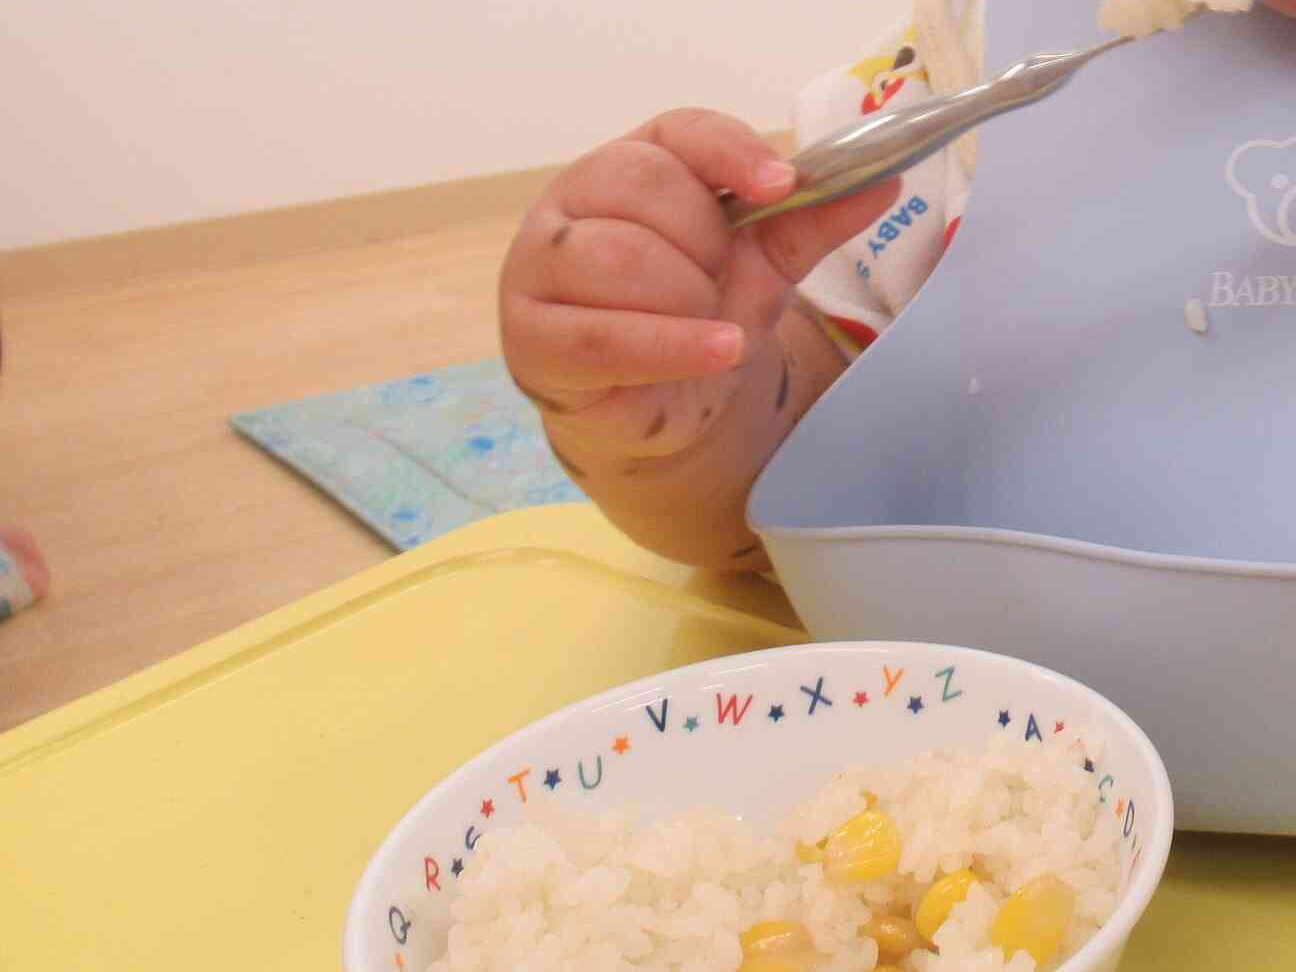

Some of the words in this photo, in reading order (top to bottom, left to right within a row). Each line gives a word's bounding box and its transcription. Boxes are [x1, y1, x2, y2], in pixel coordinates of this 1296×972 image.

[870, 195, 929, 259] BABY
[389, 906, 411, 945] Q
[424, 856, 441, 891] R
[508, 767, 531, 803] T
[578, 755, 602, 790] U
[645, 698, 668, 732] V
[716, 692, 753, 725] W
[799, 676, 832, 715] X
[883, 665, 903, 697] Y
[934, 665, 962, 702] Z
[1025, 712, 1043, 743] A
